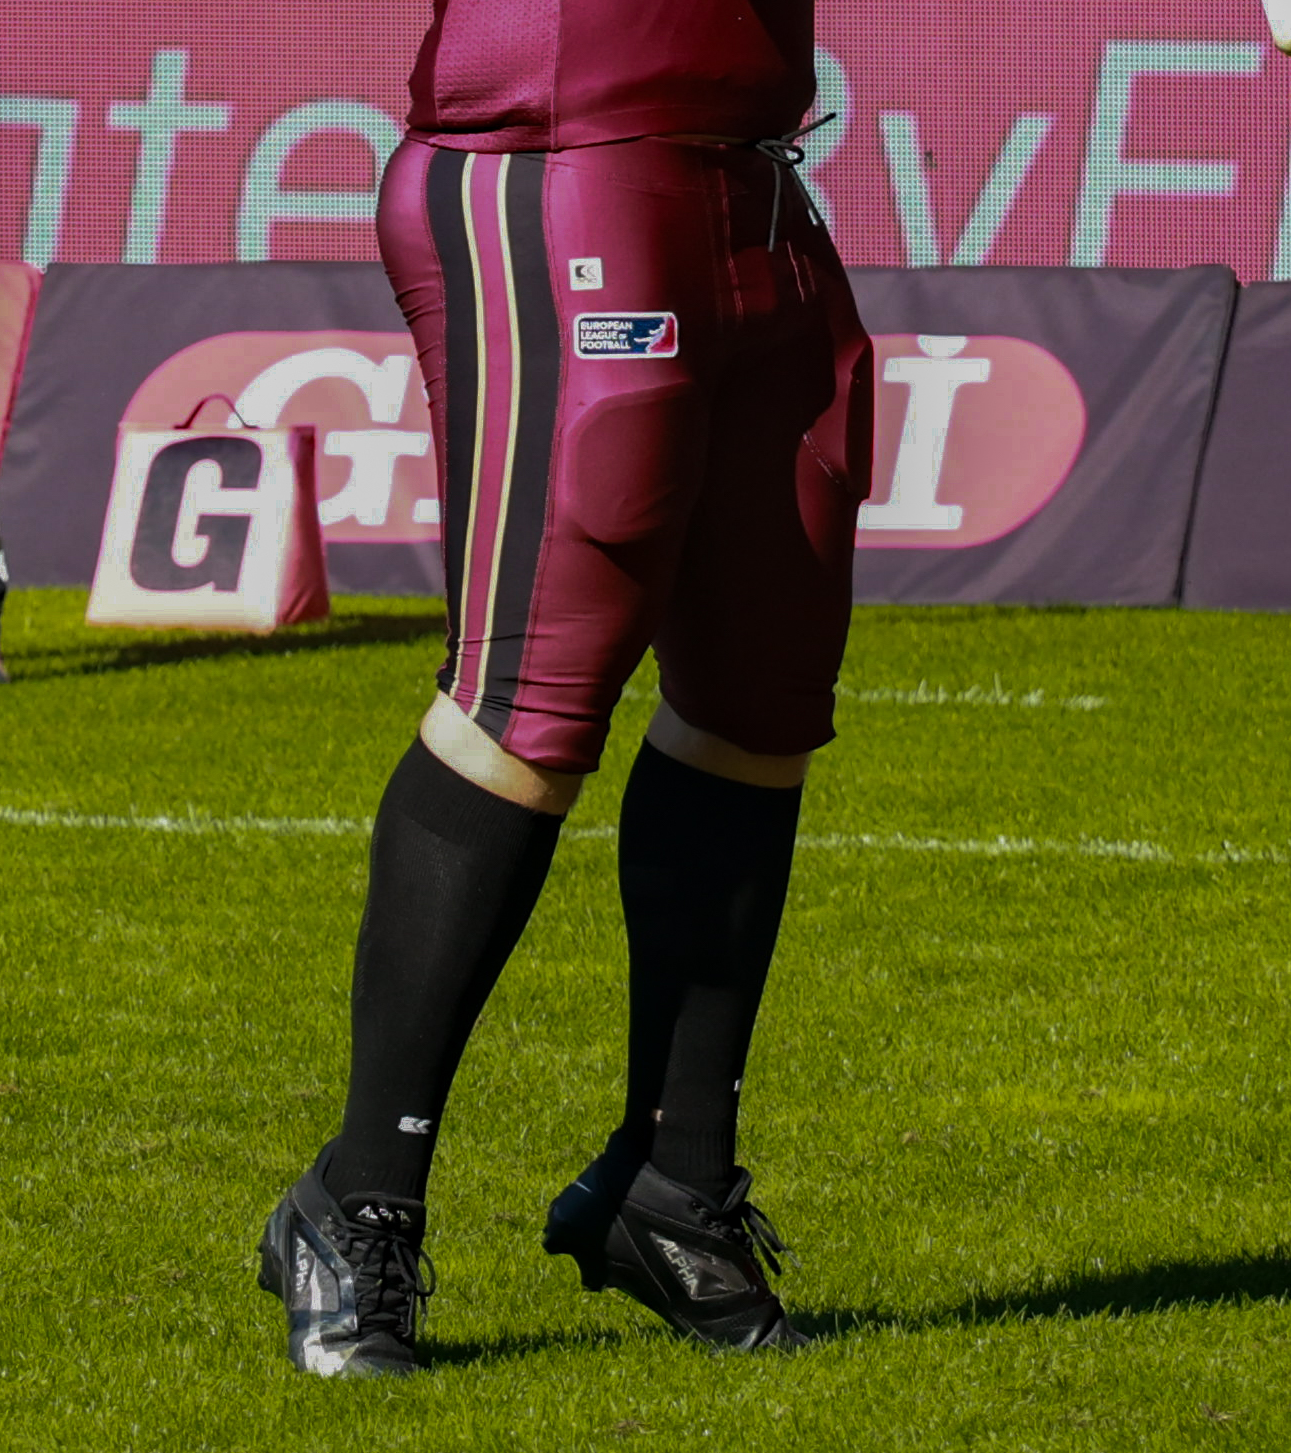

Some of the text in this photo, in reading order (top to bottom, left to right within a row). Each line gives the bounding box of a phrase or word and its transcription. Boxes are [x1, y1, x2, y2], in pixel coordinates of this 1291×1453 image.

[580, 321, 633, 331] EUROPEAN
[580, 331, 618, 340] LEAGUE
[580, 340, 631, 350] FOOTBALL
[129, 435, 262, 593] G
